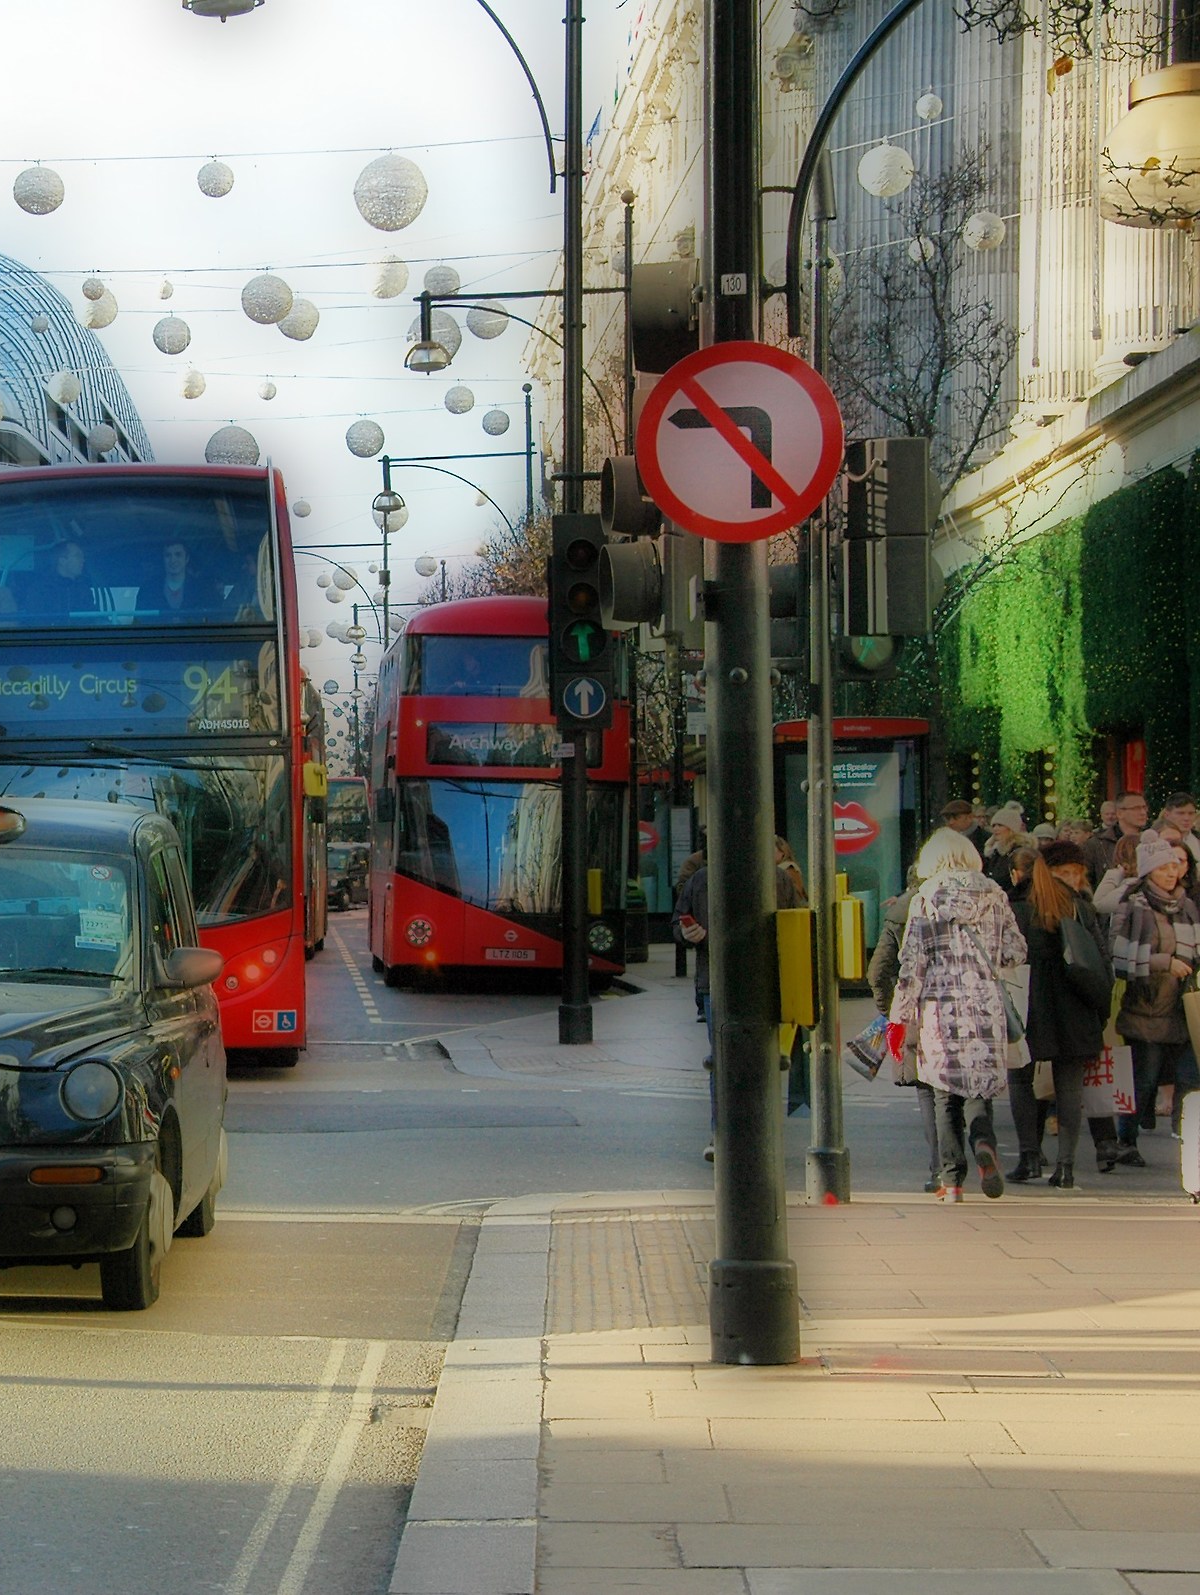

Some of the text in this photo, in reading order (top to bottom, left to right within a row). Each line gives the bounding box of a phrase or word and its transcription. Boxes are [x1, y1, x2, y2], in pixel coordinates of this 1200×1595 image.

[726, 277, 741, 292] 130
[79, 673, 137, 694] Circus
[183, 665, 238, 705] 94
[199, 718, 250, 731] ADH45016
[448, 734, 523, 755] Archway
